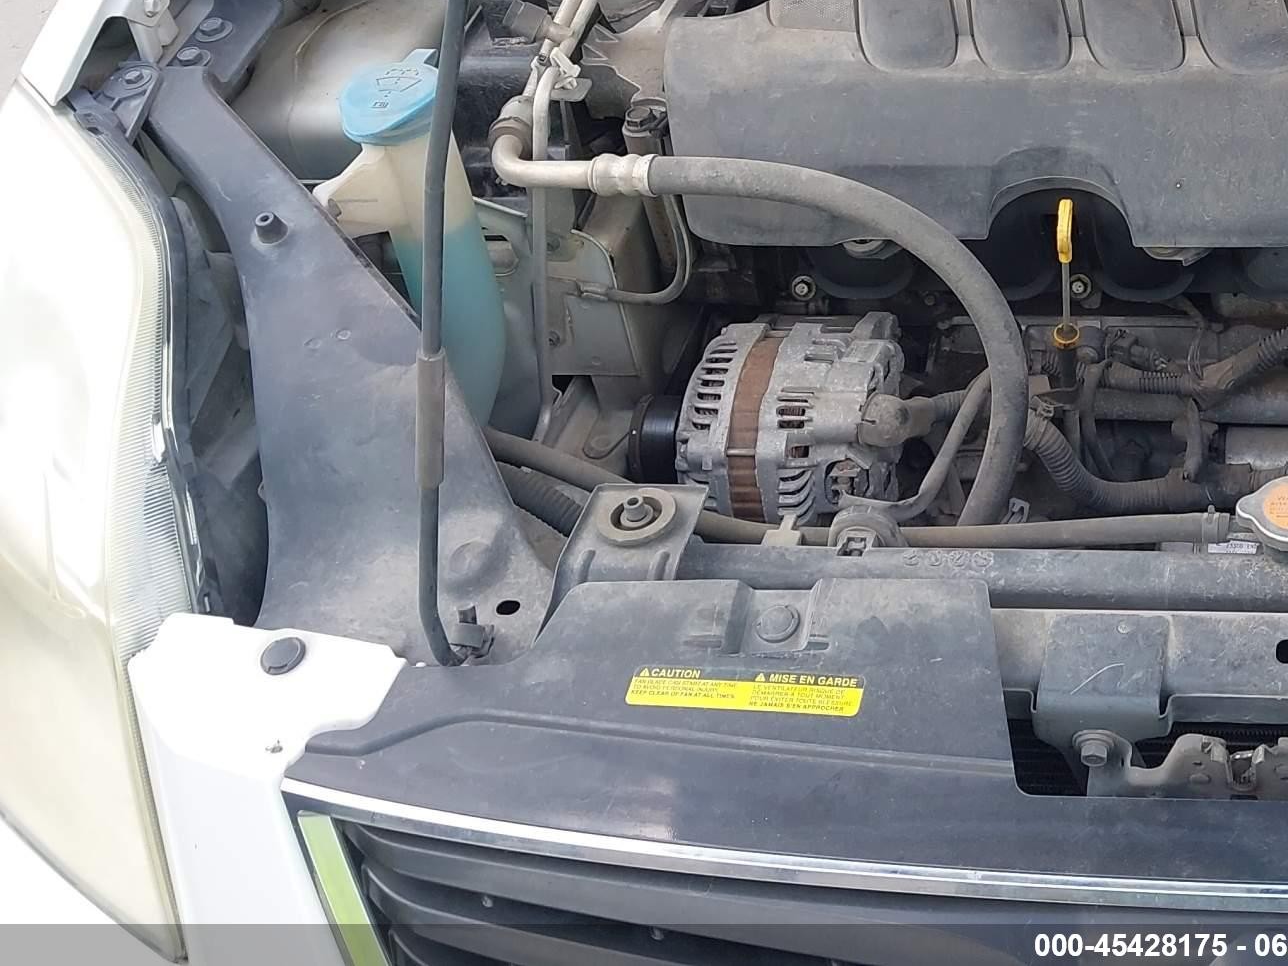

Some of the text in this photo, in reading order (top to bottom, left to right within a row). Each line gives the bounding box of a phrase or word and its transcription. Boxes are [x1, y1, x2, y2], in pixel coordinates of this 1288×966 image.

[651, 668, 701, 678] CAUTION
[769, 674, 858, 687] MISE EN GARDE
